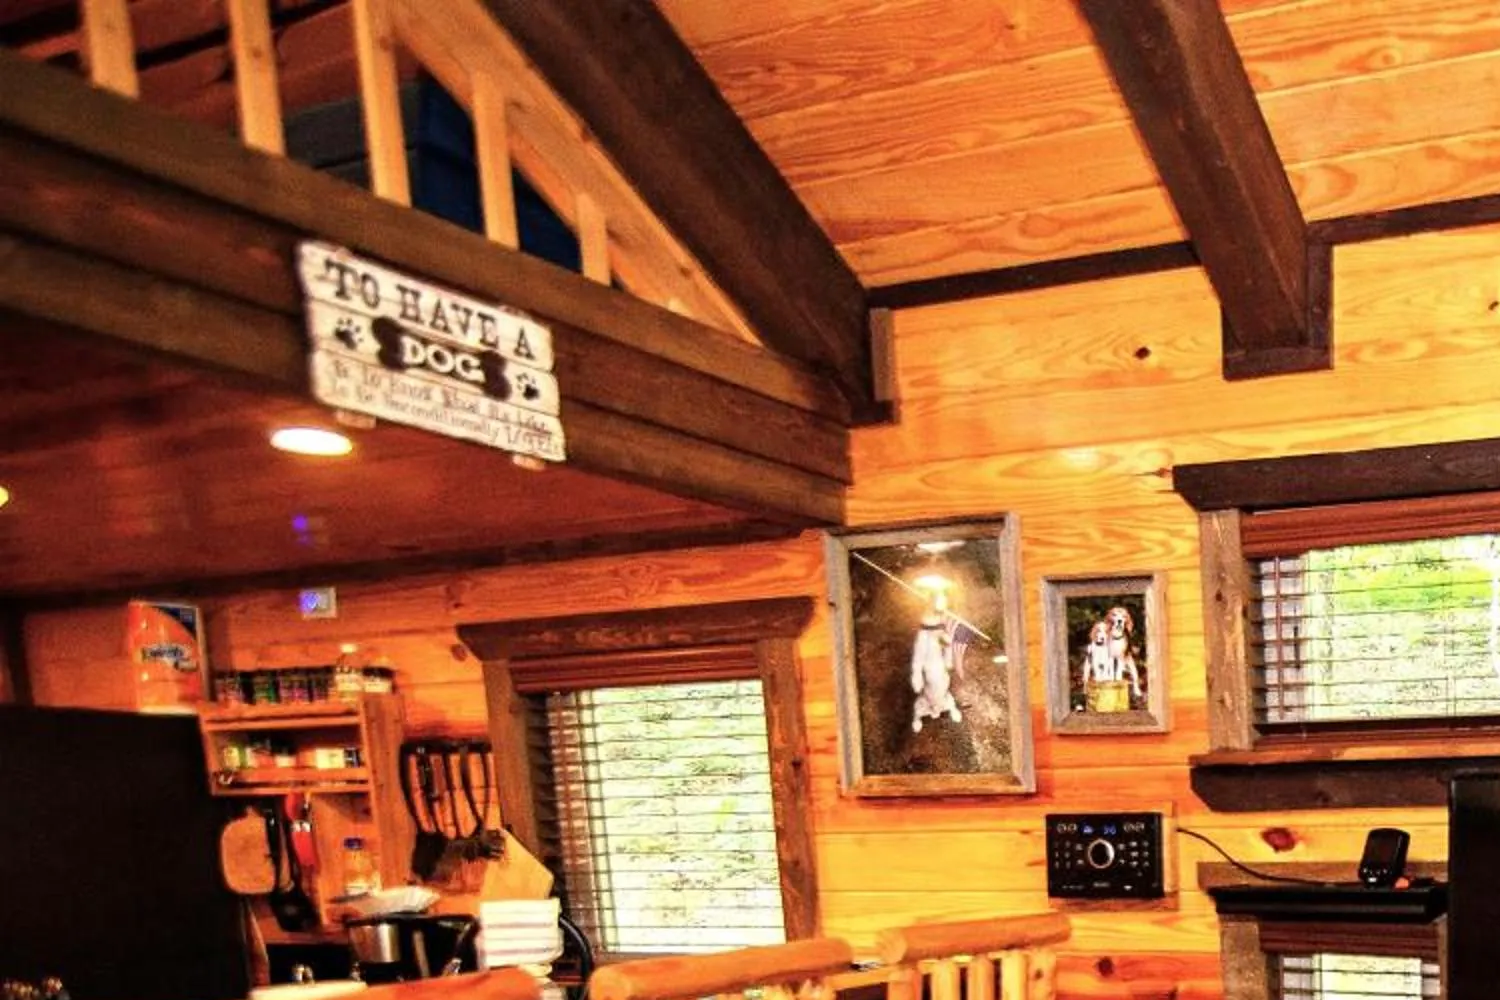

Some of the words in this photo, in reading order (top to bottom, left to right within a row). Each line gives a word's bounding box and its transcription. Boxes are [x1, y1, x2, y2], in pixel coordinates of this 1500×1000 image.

[324, 259, 380, 309] TO
[396, 284, 499, 349] HAVE
[514, 327, 536, 360] A
[402, 335, 486, 383] DOG
